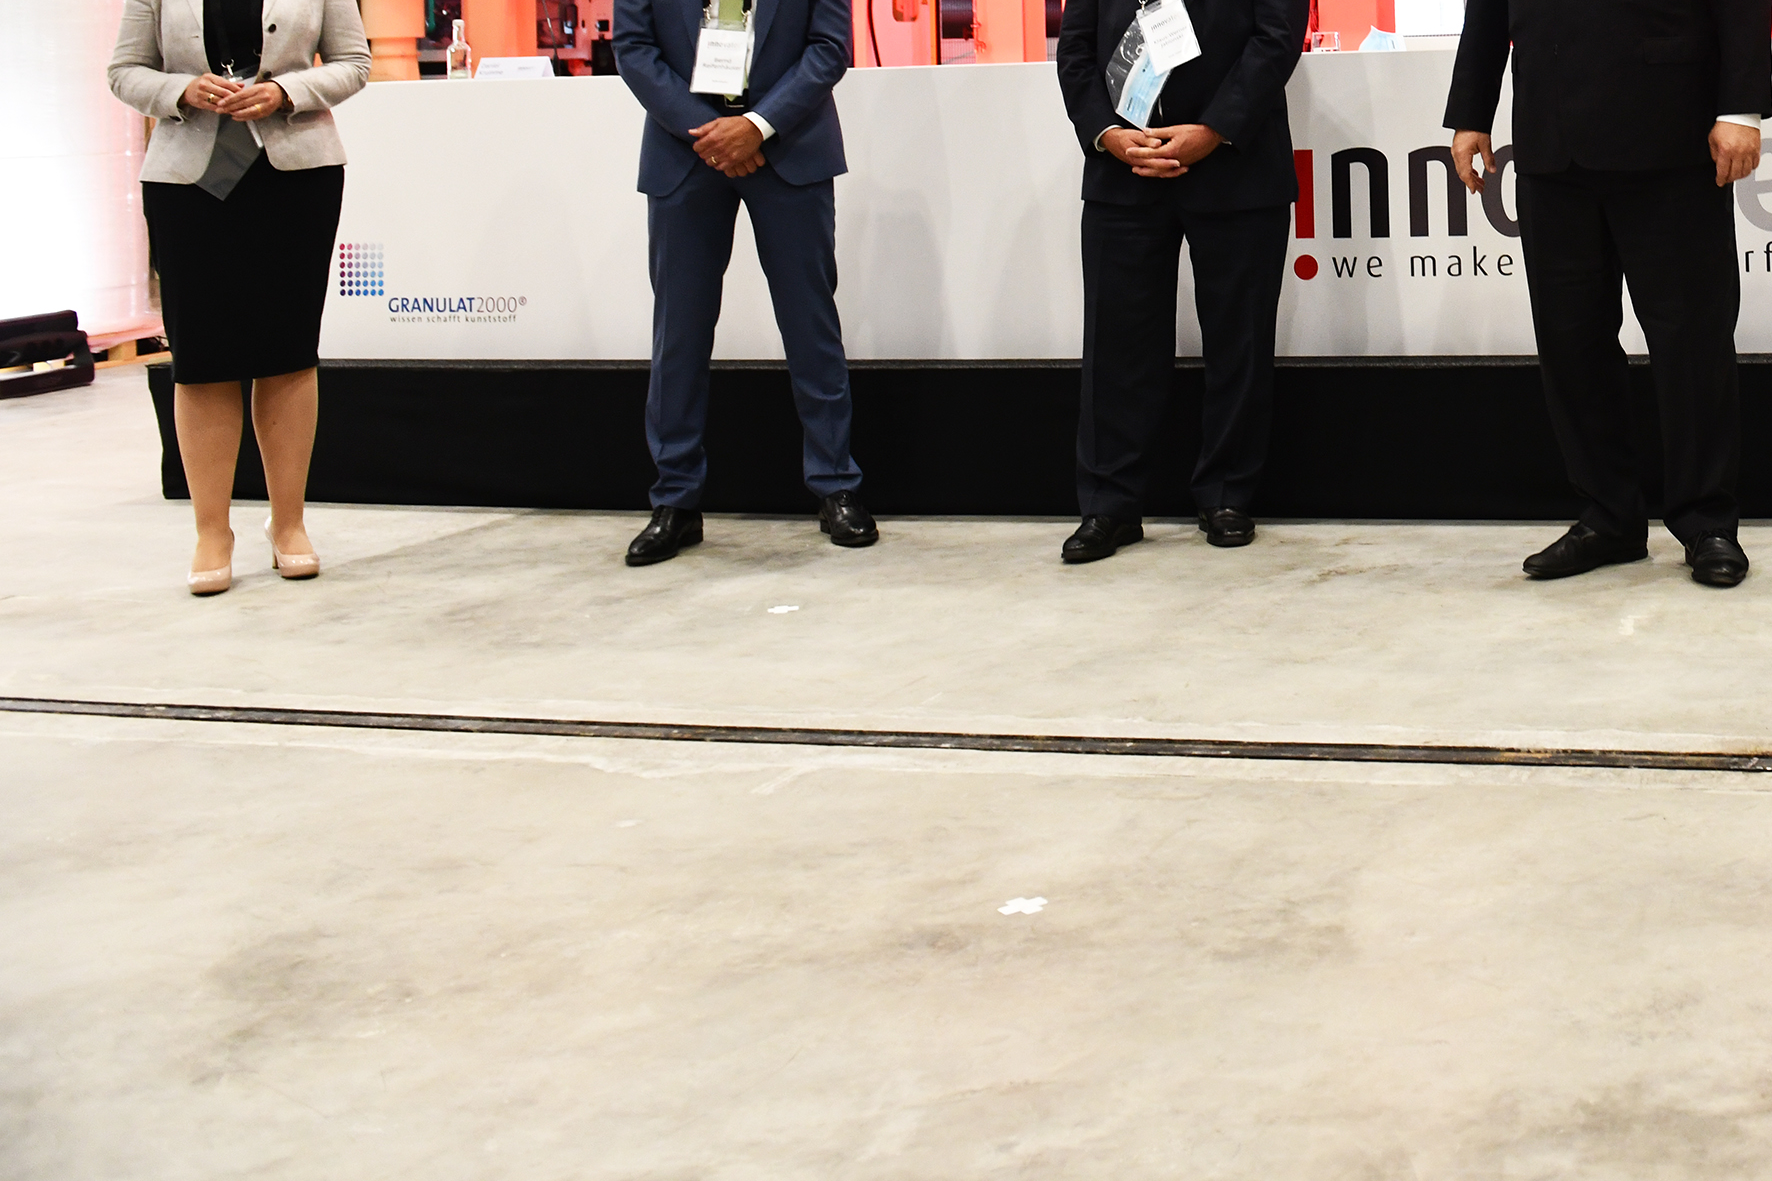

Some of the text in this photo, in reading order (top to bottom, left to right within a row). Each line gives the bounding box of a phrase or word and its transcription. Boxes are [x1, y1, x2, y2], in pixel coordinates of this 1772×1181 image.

[1331, 254, 1383, 278] we
[1410, 246, 1514, 277] make
[389, 314, 517, 323] wissen schafft kunststoff
